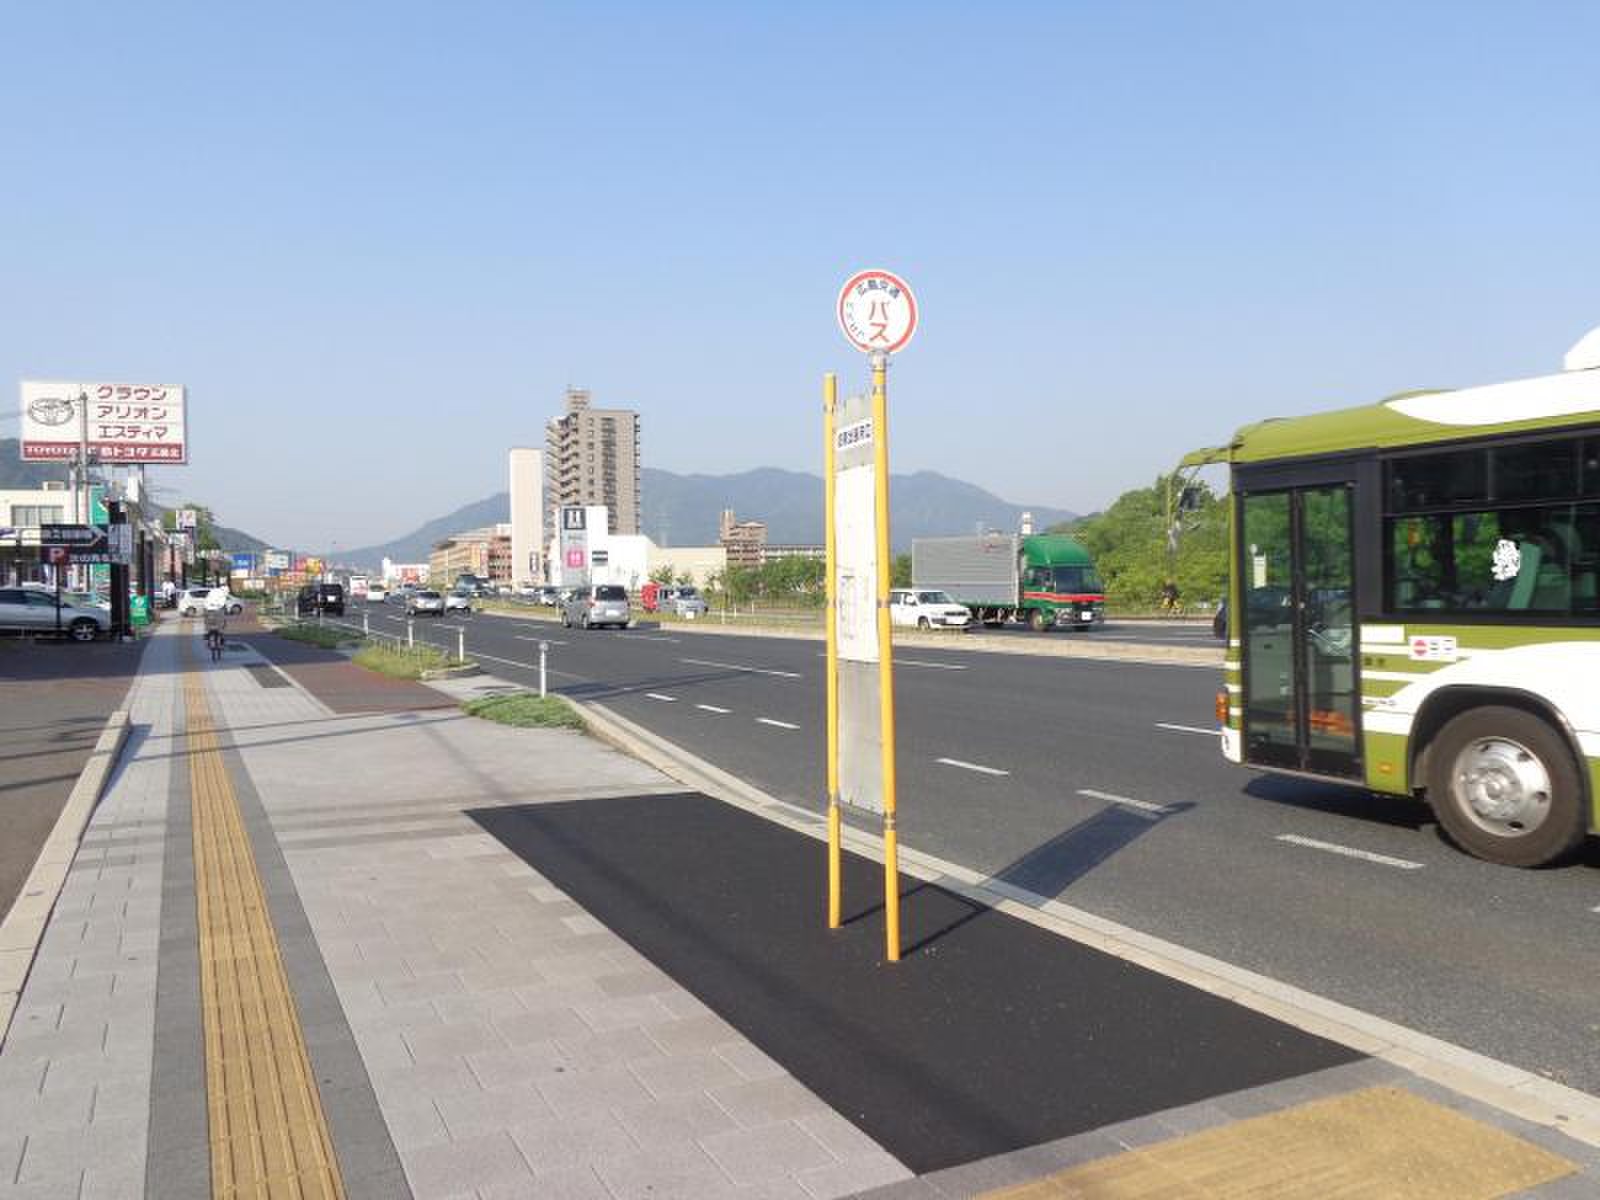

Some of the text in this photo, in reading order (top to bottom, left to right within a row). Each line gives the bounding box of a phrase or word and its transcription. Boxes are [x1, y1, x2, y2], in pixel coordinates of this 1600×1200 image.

[868, 299, 890, 343] バス
[97, 386, 167, 401] クラウン
[97, 405, 167, 419] アリオン
[98, 425, 168, 439] エスティマ
